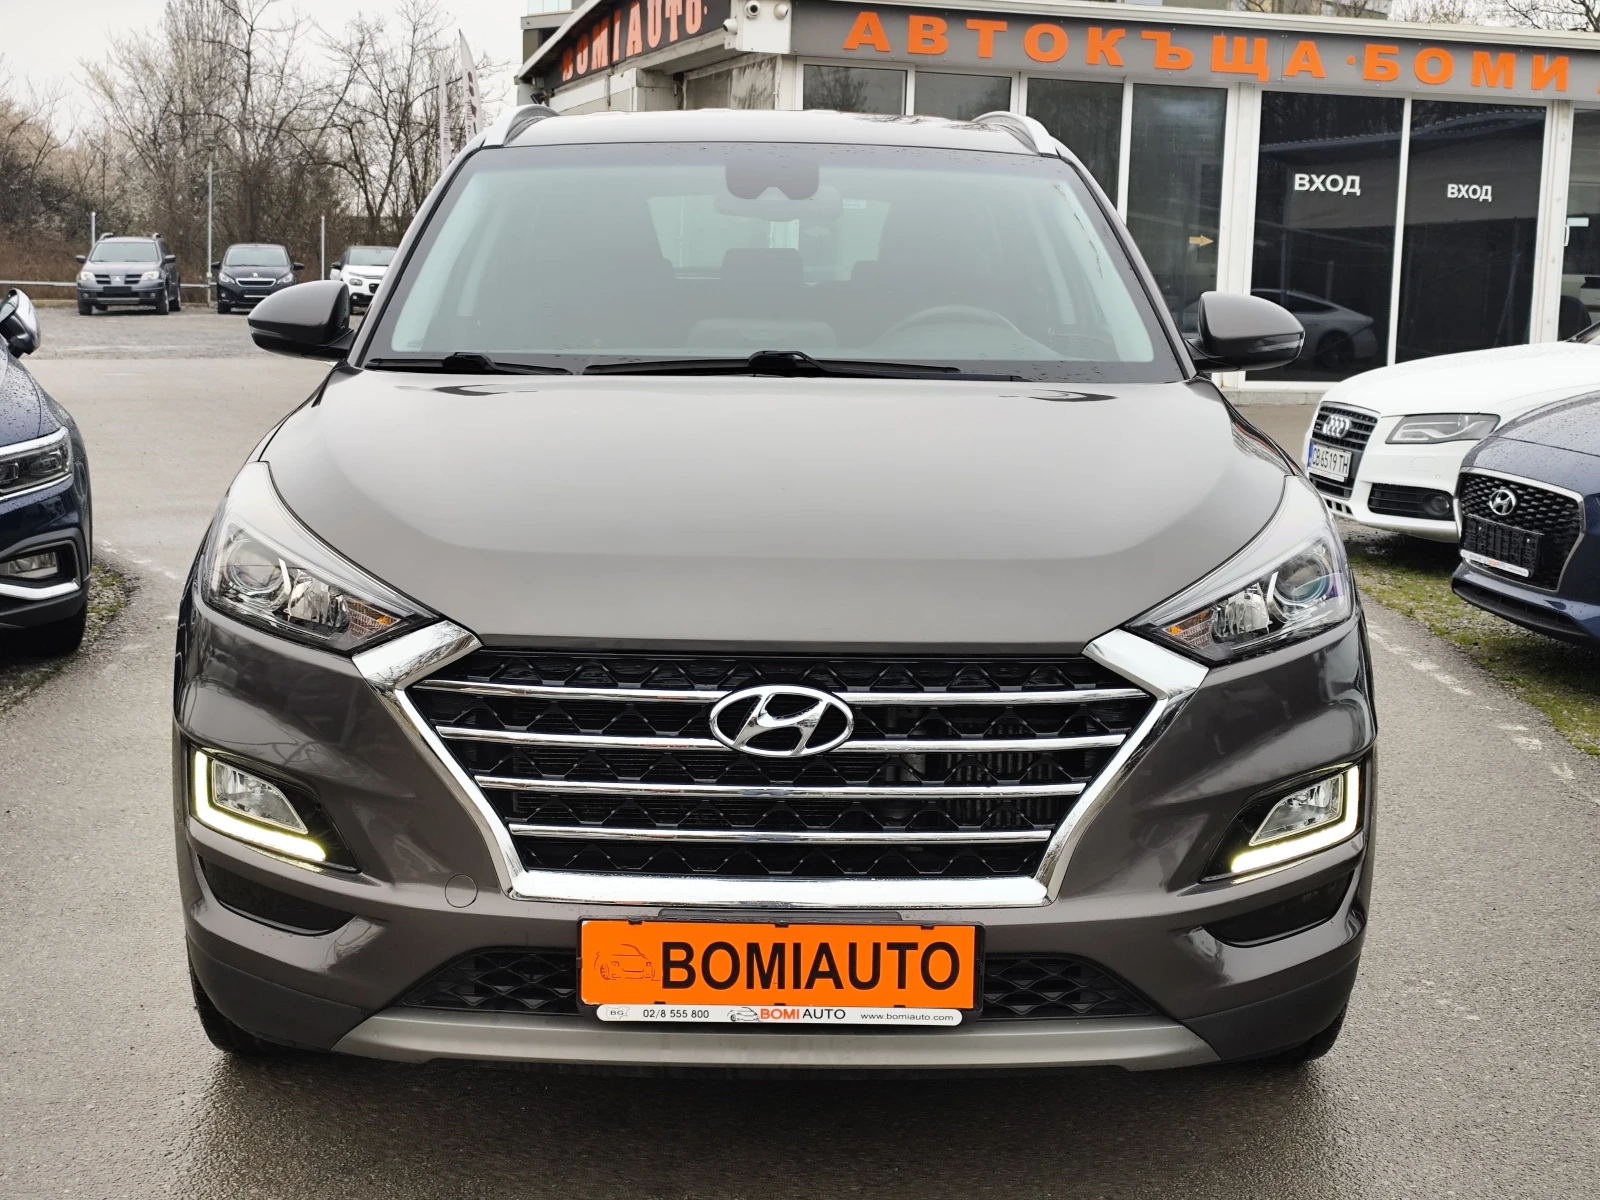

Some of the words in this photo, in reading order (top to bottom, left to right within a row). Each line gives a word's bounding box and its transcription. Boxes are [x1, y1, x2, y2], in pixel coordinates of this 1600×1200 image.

[561, 0, 703, 82] BOMIAUTO
[843, 11, 1326, 82] АВТОКЪЩА
[1363, 44, 1570, 91] БОМИ
[1294, 173, 1361, 196] ВХОД
[1447, 183, 1492, 202] ВХОД
[661, 941, 960, 991] BOMIAUTO
[643, 1009, 666, 1018] 02/8
[670, 1009, 688, 1018] 555
[691, 1010, 710, 1019] 800
[760, 1008, 800, 1020] BOMI
[802, 1009, 846, 1020] AUTO
[860, 1012, 954, 1021] www.bomiauto.com
